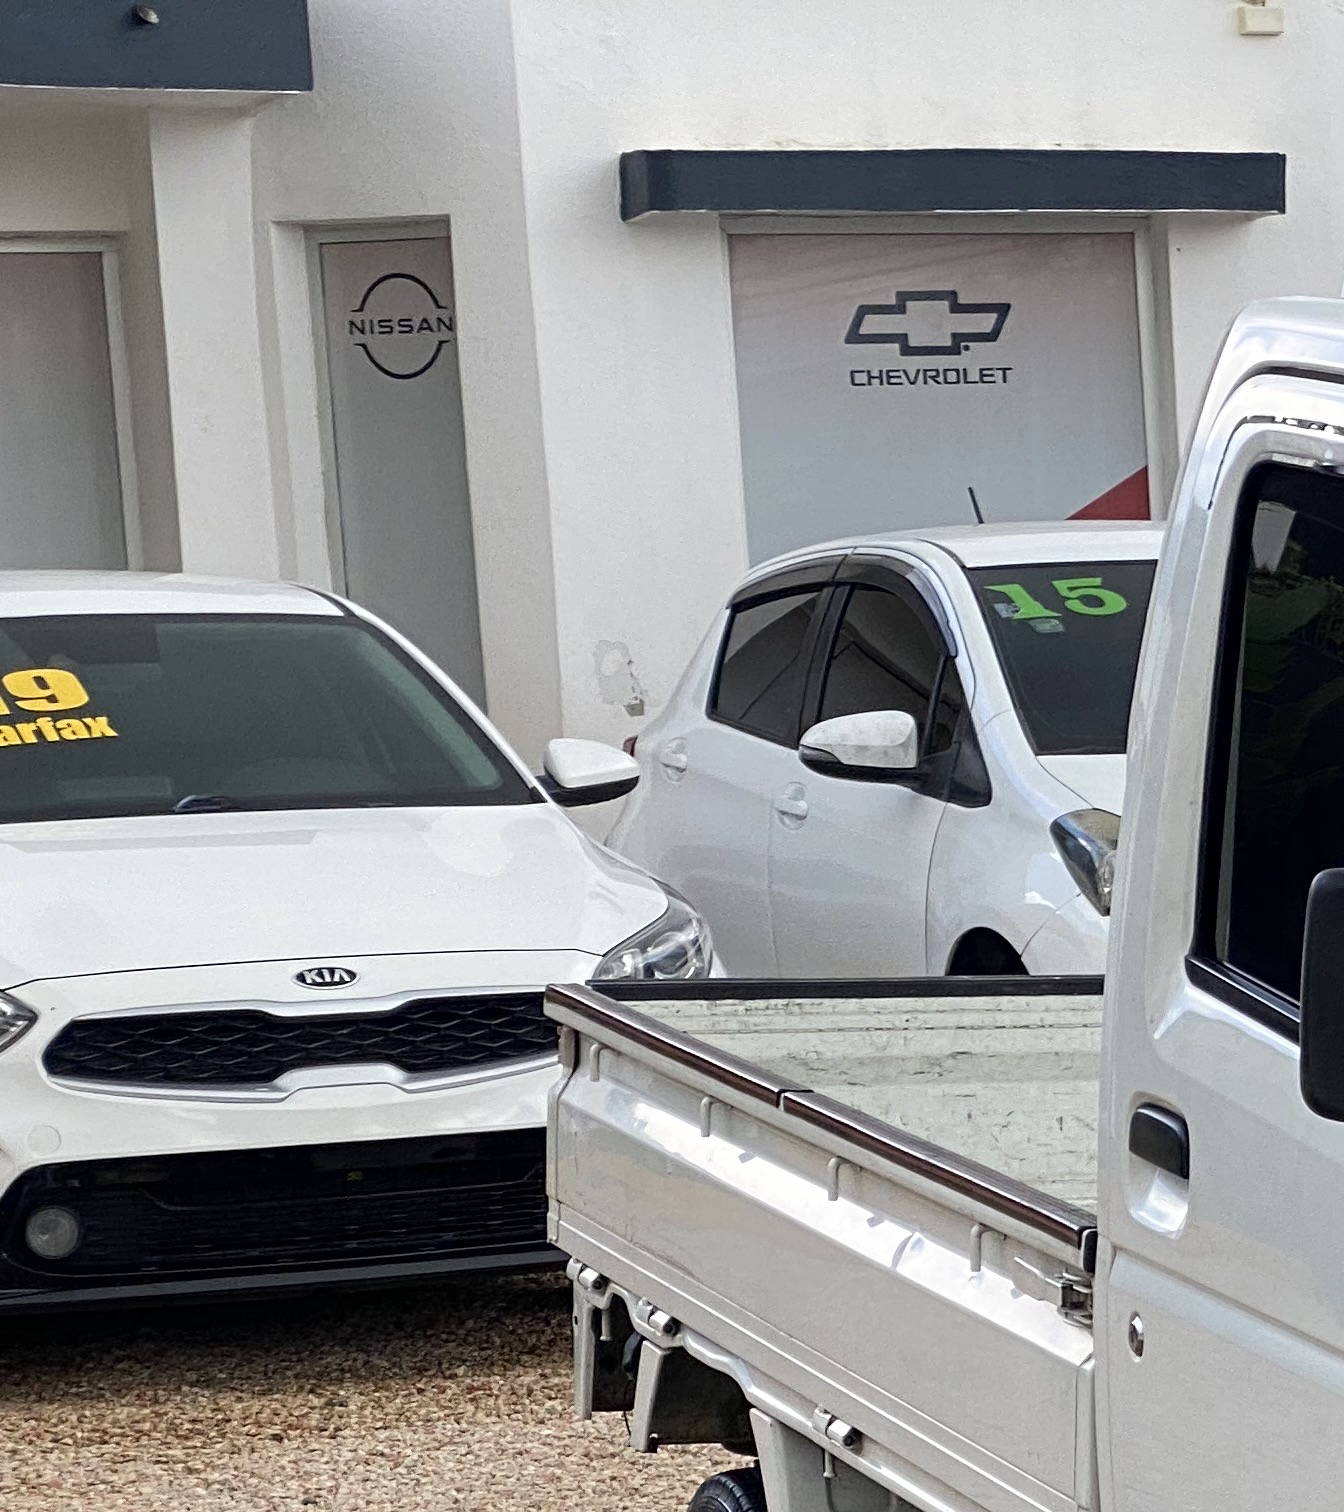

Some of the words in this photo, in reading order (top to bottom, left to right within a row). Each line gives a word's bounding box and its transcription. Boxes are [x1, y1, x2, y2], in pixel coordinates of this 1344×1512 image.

[348, 316, 454, 335] NISSAN
[850, 367, 1013, 387] CHEVROLET
[984, 577, 1127, 620] 15
[0, 668, 90, 716] 9
[302, 968, 351, 984] KIA
